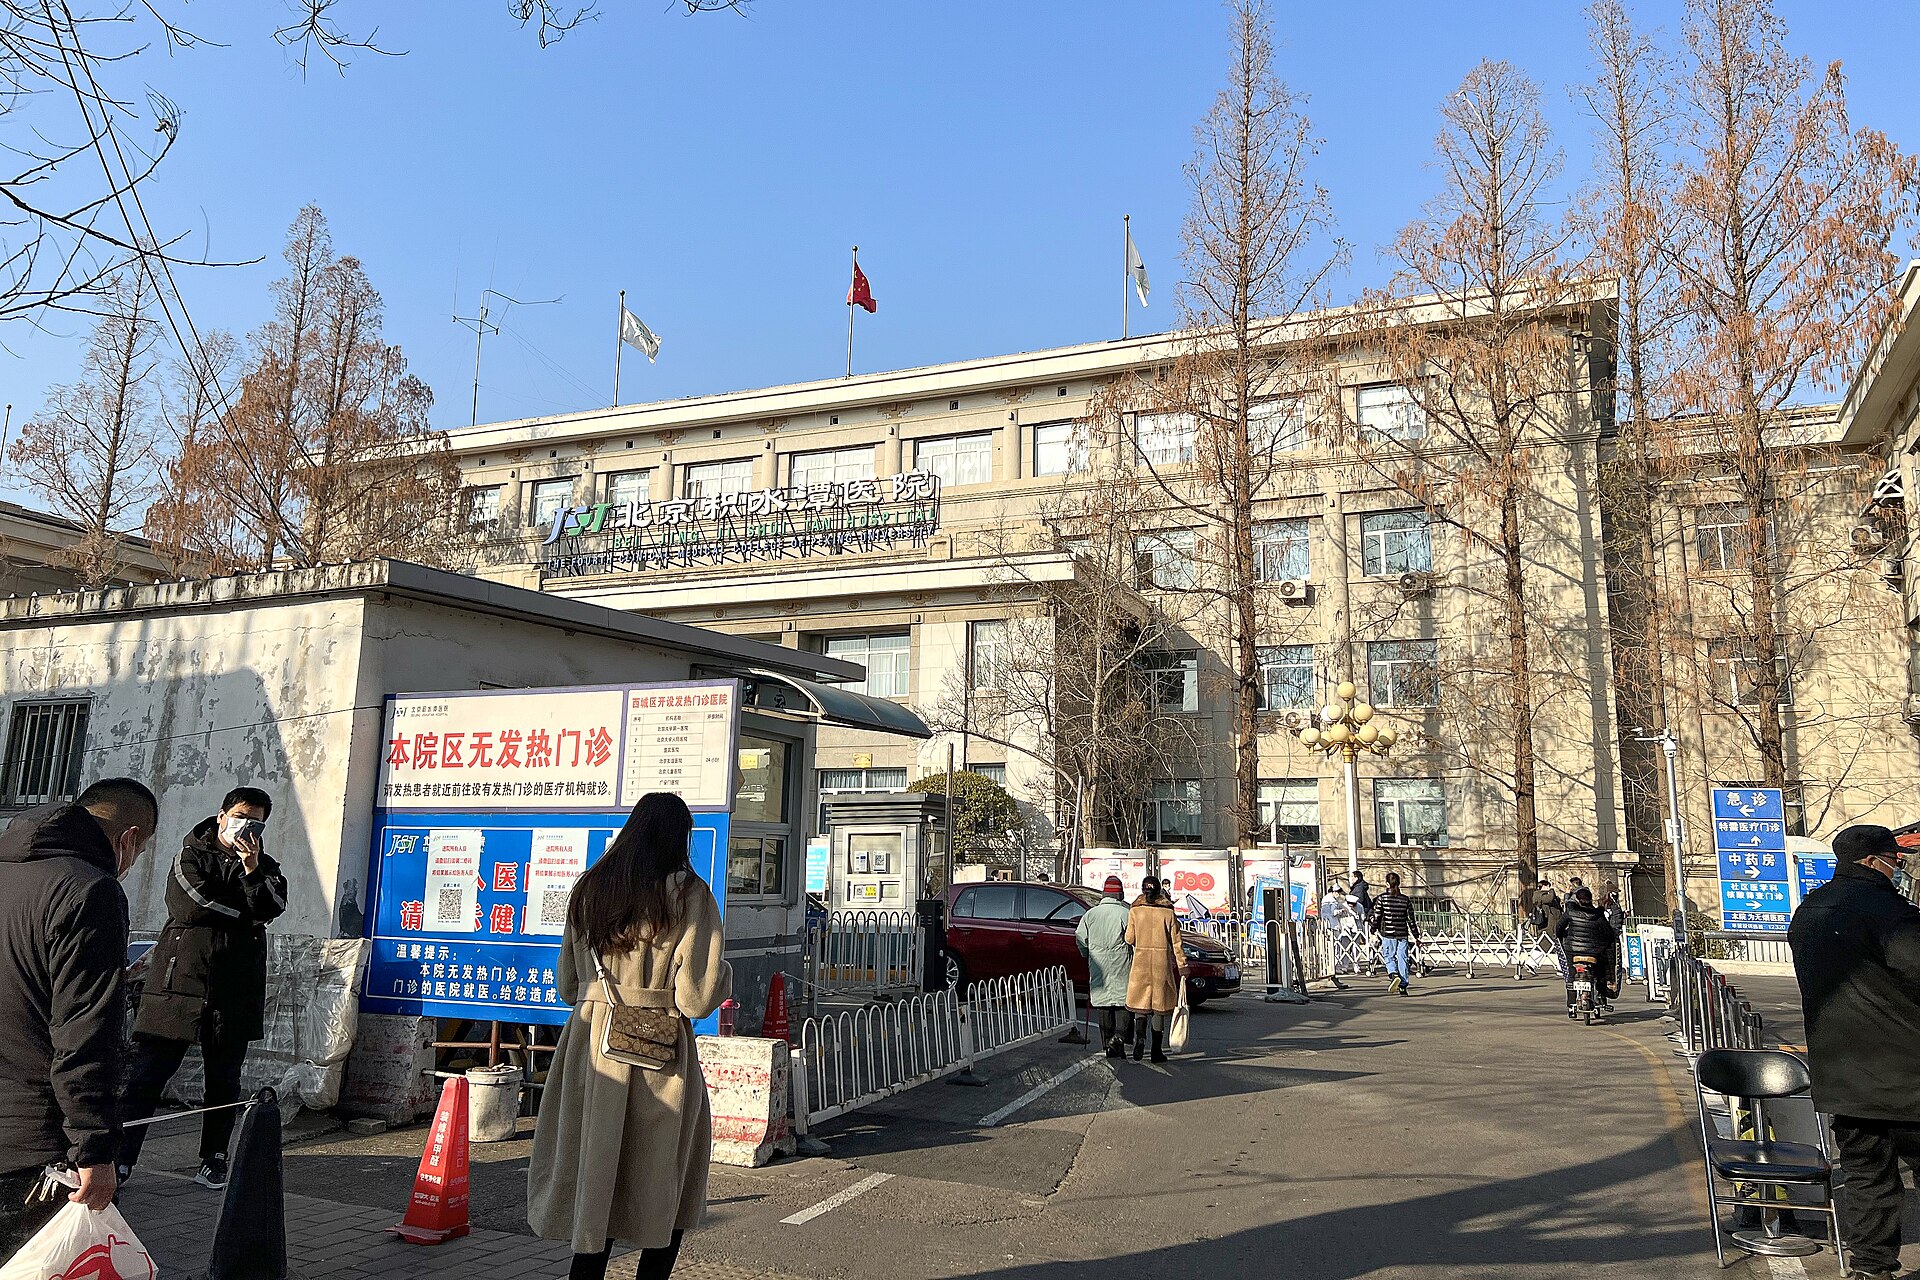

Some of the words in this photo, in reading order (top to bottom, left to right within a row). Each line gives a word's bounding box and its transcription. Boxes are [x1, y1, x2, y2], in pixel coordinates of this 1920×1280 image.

[614, 468, 936, 530] 北京积水潭医院
[613, 533, 641, 550] BEI
[658, 528, 700, 547] JING
[747, 520, 788, 537] SHUI
[804, 516, 833, 533] TAN
[846, 507, 937, 529] HOSPITAL
[547, 558, 566, 572] THE
[572, 552, 613, 569] FOURTH
[619, 548, 671, 565] CLINICAL
[677, 544, 726, 559] MEDICAL
[733, 538, 785, 554] COLLEGE
[791, 536, 805, 549] OF
[811, 532, 853, 548] PEKING
[861, 524, 937, 543] UNIVERSITY
[631, 693, 729, 709] 西城区开设发热门诊医院
[386, 726, 613, 770] 本院区无发热门诊
[1726, 791, 1767, 807] 急诊
[1718, 821, 1781, 833] 特需医疗门诊
[1728, 853, 1776, 867] 中药房
[1730, 883, 1779, 892] 社区医学科
[1731, 912, 1787, 922] 本院为无烟医院
[1628, 937, 1642, 976] 公安交通
[393, 978, 563, 1004] 门诊的医院就医。给您造成
